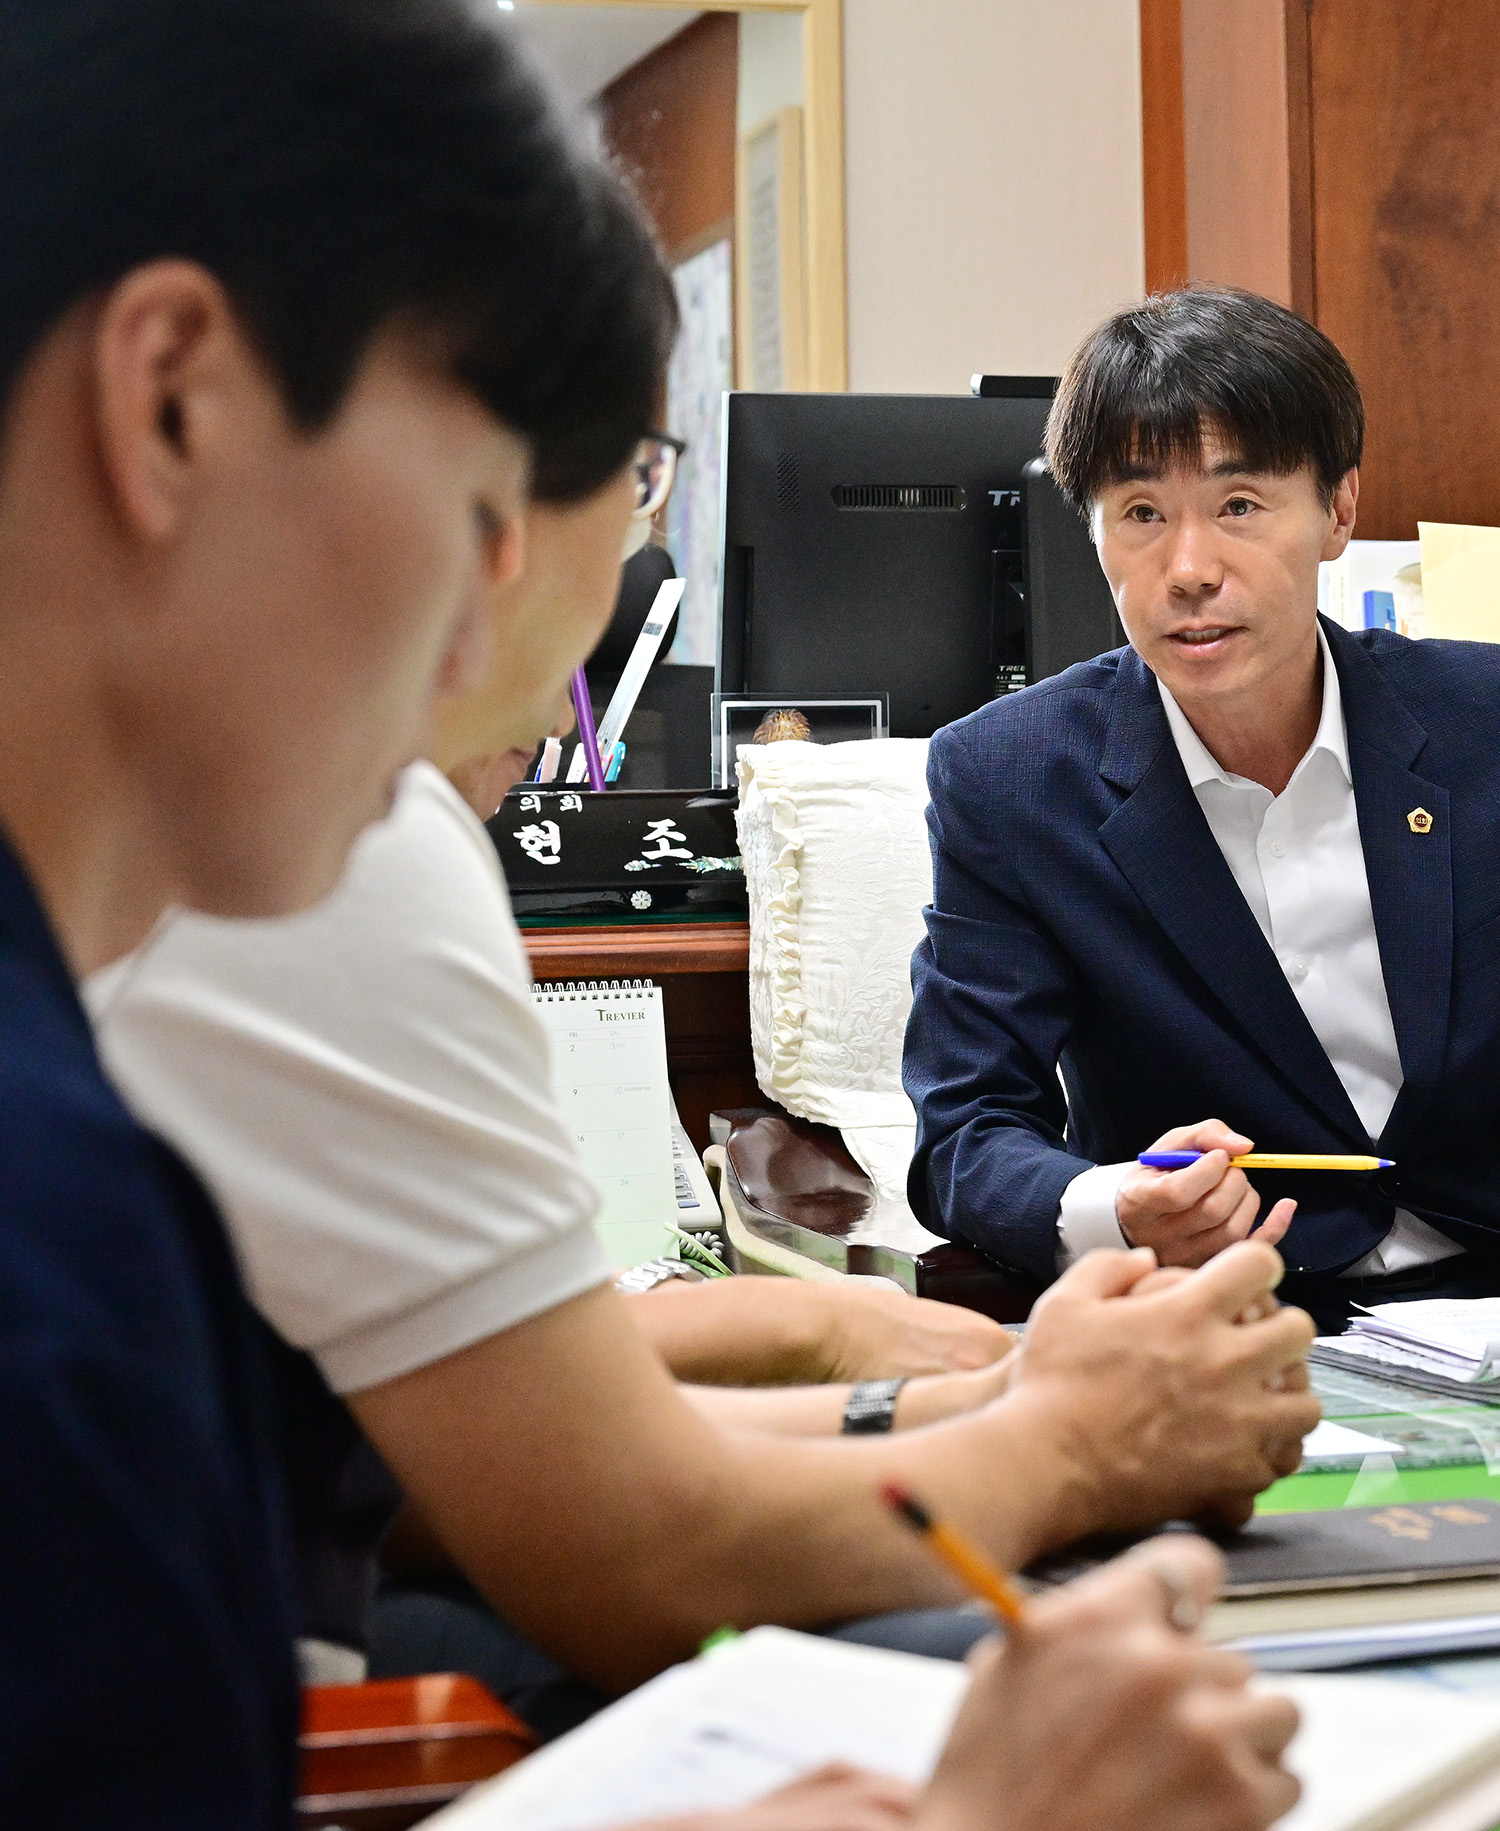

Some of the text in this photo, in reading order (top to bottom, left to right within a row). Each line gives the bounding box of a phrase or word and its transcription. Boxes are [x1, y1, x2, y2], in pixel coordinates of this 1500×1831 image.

[570, 1044, 575, 1052] 2
[572, 1088, 578, 1096] 9
[617, 1132, 625, 1140] 17
[620, 1178, 629, 1187] 24
